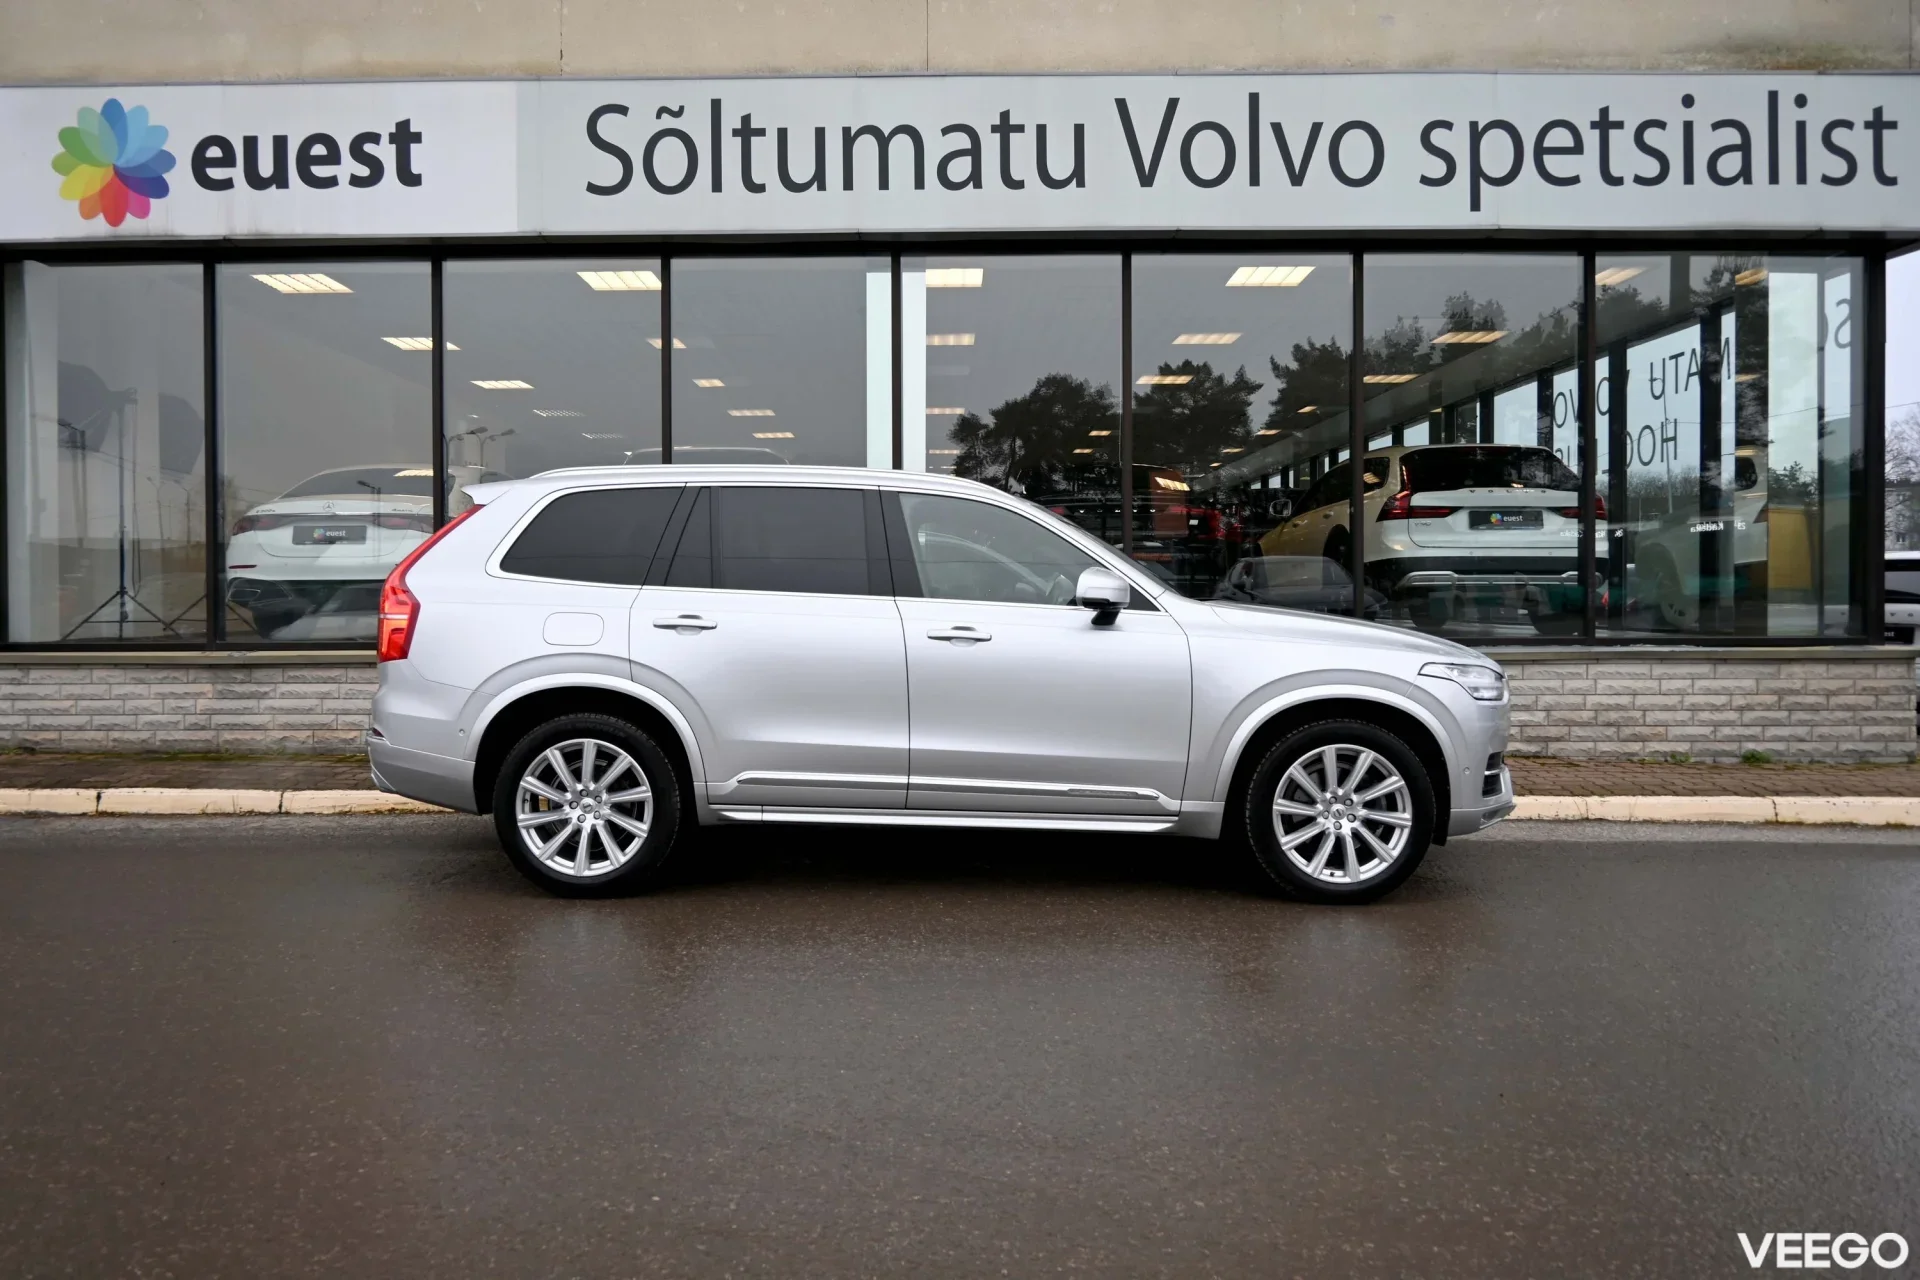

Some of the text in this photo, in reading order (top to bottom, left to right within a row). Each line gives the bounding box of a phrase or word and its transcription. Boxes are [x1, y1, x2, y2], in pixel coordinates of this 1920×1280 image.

[192, 119, 422, 191] euest
[586, 90, 1899, 211] Sõltumatu Volvo spetsialist
[1503, 514, 1523, 522] euest
